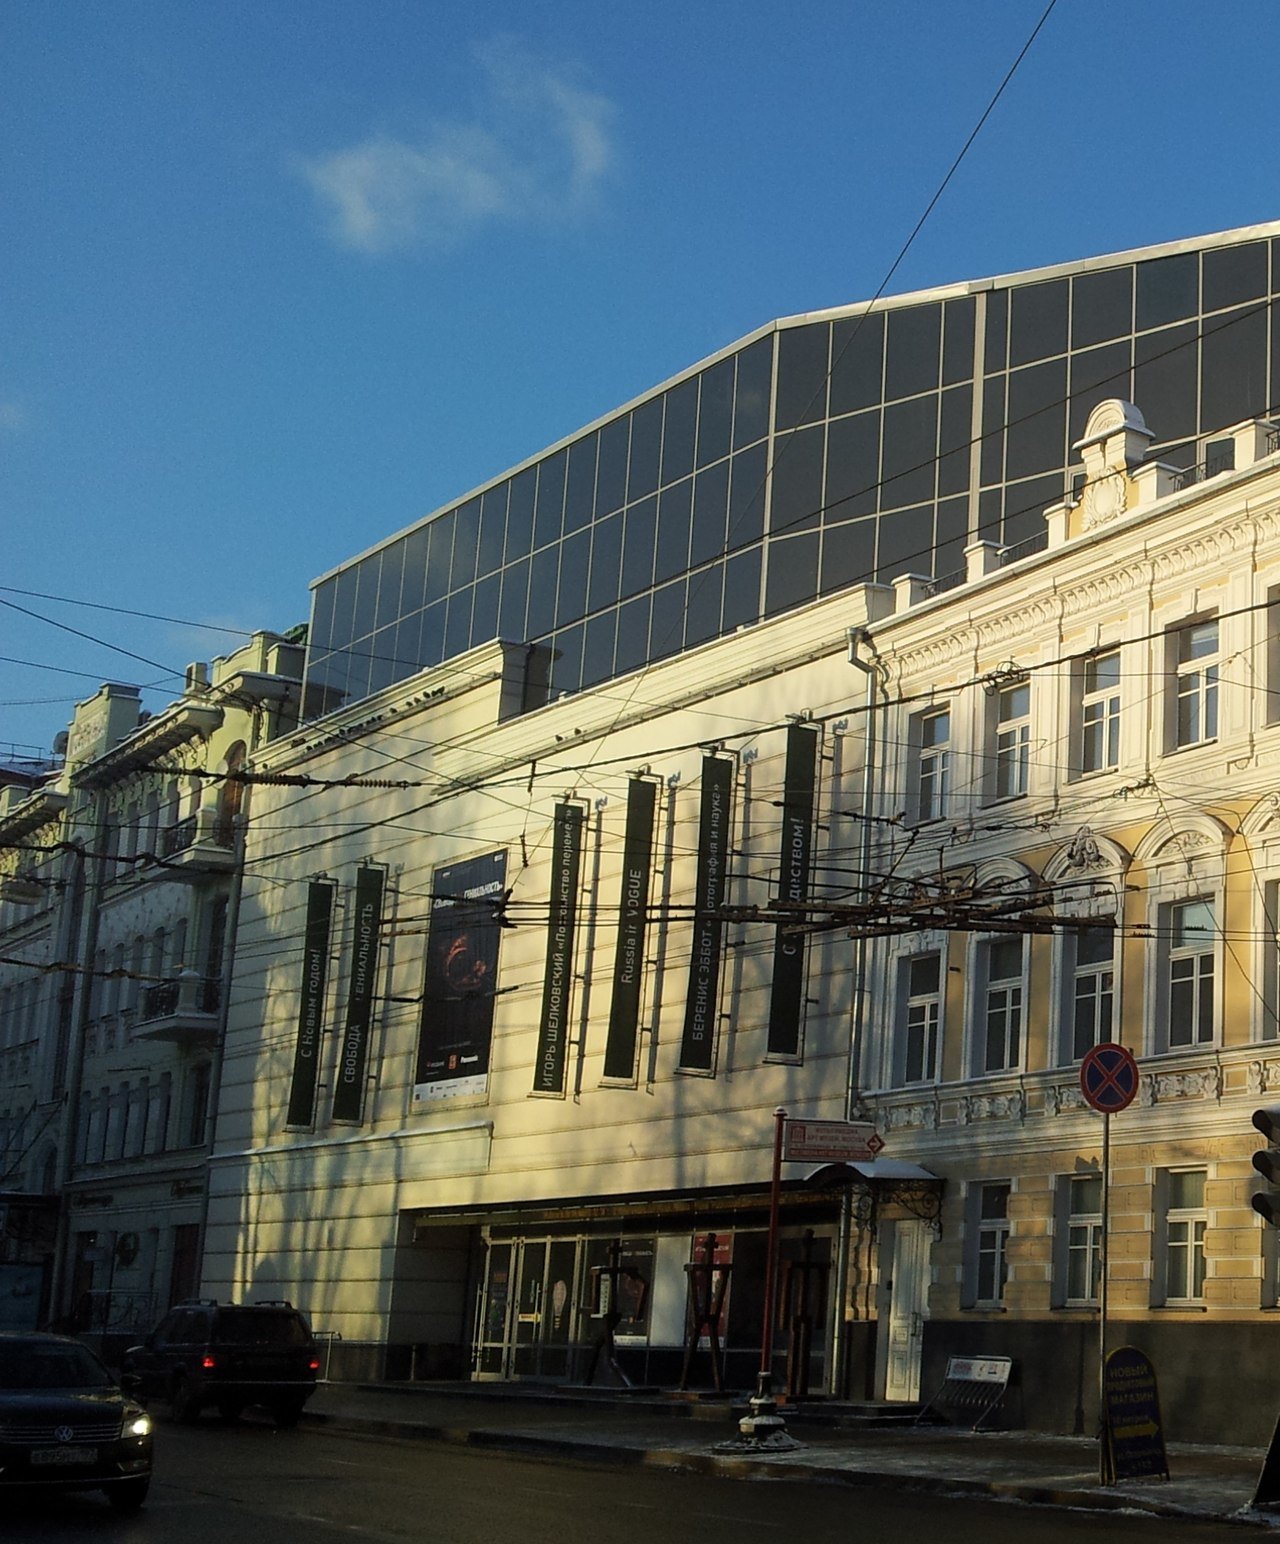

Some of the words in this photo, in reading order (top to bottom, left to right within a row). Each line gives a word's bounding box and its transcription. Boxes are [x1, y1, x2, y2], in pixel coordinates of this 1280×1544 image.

[626, 868, 642, 917] VOGUE
[620, 938, 636, 984] Russia
[699, 930, 713, 974] ЭББОТ
[301, 1049, 312, 1058] С
[309, 949, 321, 995] годом!
[547, 952, 565, 1042] ШЕЛКОВСКИЙ
[692, 978, 709, 1041] БЕРЕНИС
[344, 1023, 361, 1084] СВОБОДА
[542, 1044, 557, 1087] ИГОРЬ
